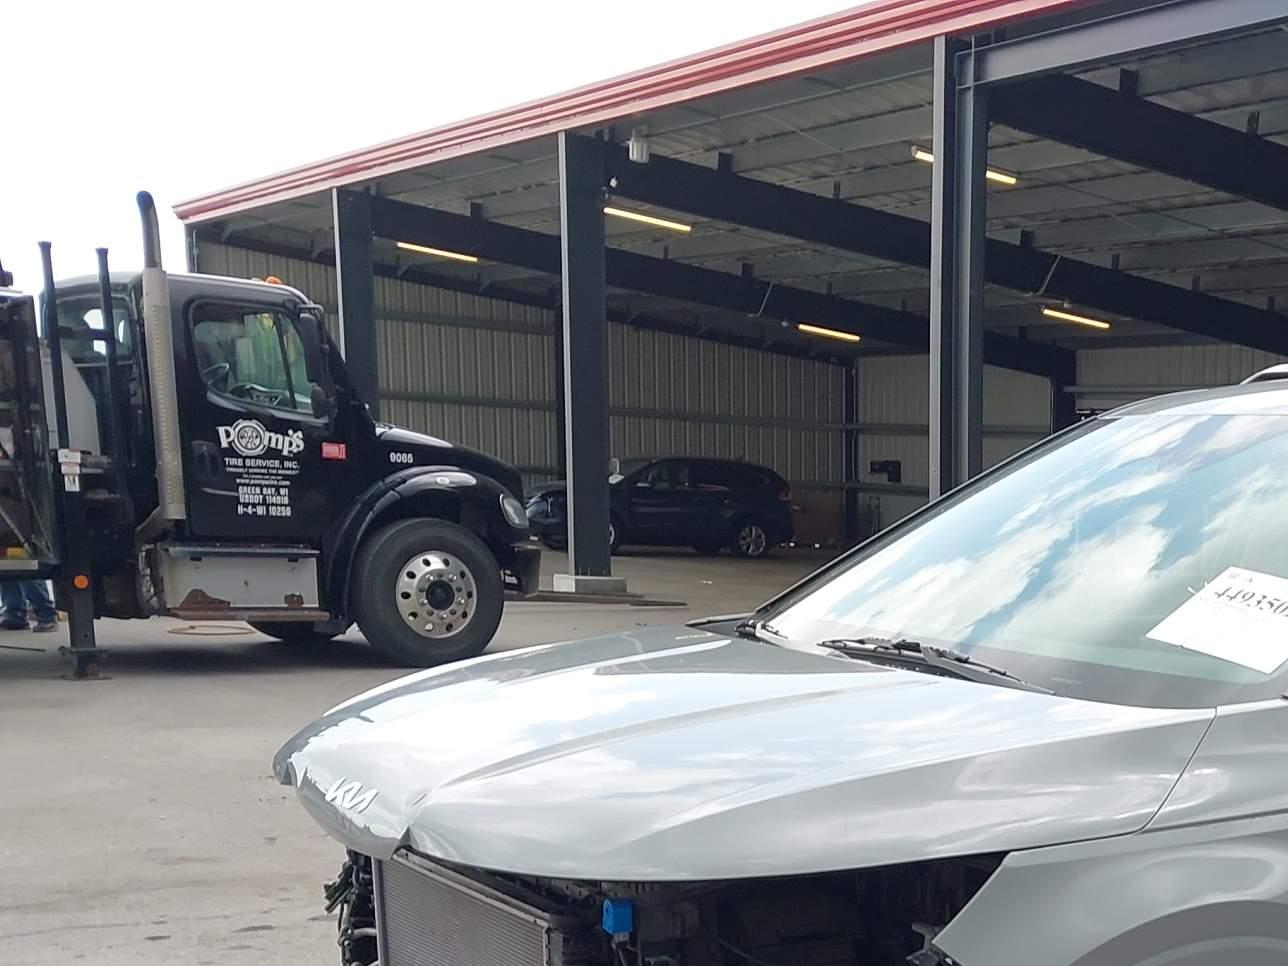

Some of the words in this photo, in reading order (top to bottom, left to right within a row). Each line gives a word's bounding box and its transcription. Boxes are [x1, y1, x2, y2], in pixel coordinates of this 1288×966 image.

[216, 418, 305, 457] Pomp's
[224, 457, 243, 467] TIRE
[238, 486, 261, 495] GREEN
[279, 487, 289, 496] WI
[239, 494, 264, 504] USDOT
